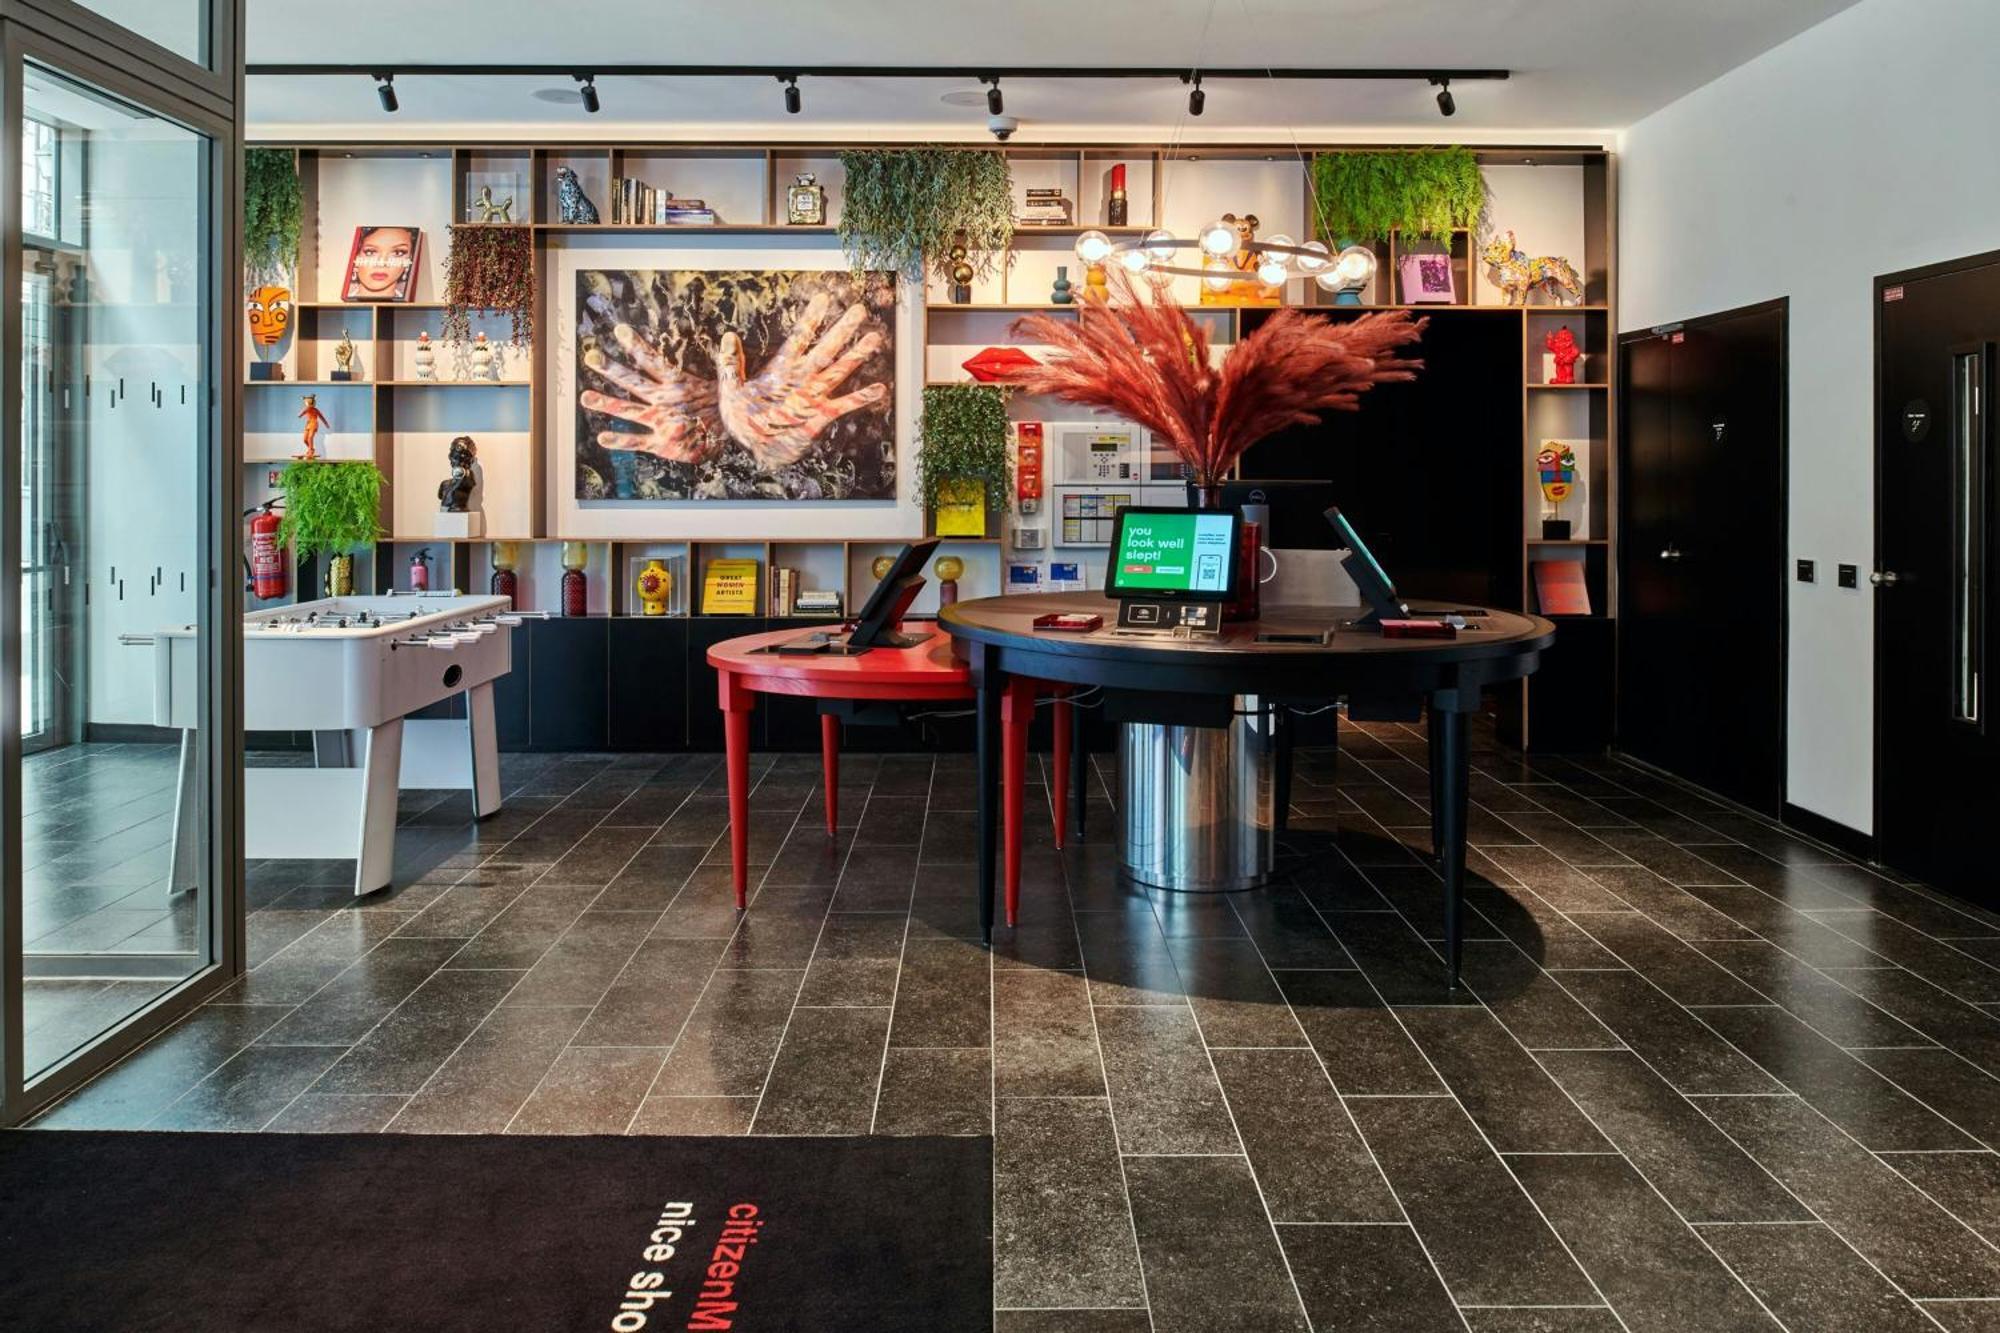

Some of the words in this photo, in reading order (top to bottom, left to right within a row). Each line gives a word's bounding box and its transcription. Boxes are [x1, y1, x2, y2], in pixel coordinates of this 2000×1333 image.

[1128, 527, 1152, 539] you
[1127, 537, 1154, 547] look
[1158, 538, 1184, 549] well
[1126, 549, 1161, 562] slept!
[642, 1201, 697, 1262] nice
[687, 1203, 764, 1330] citizenM
